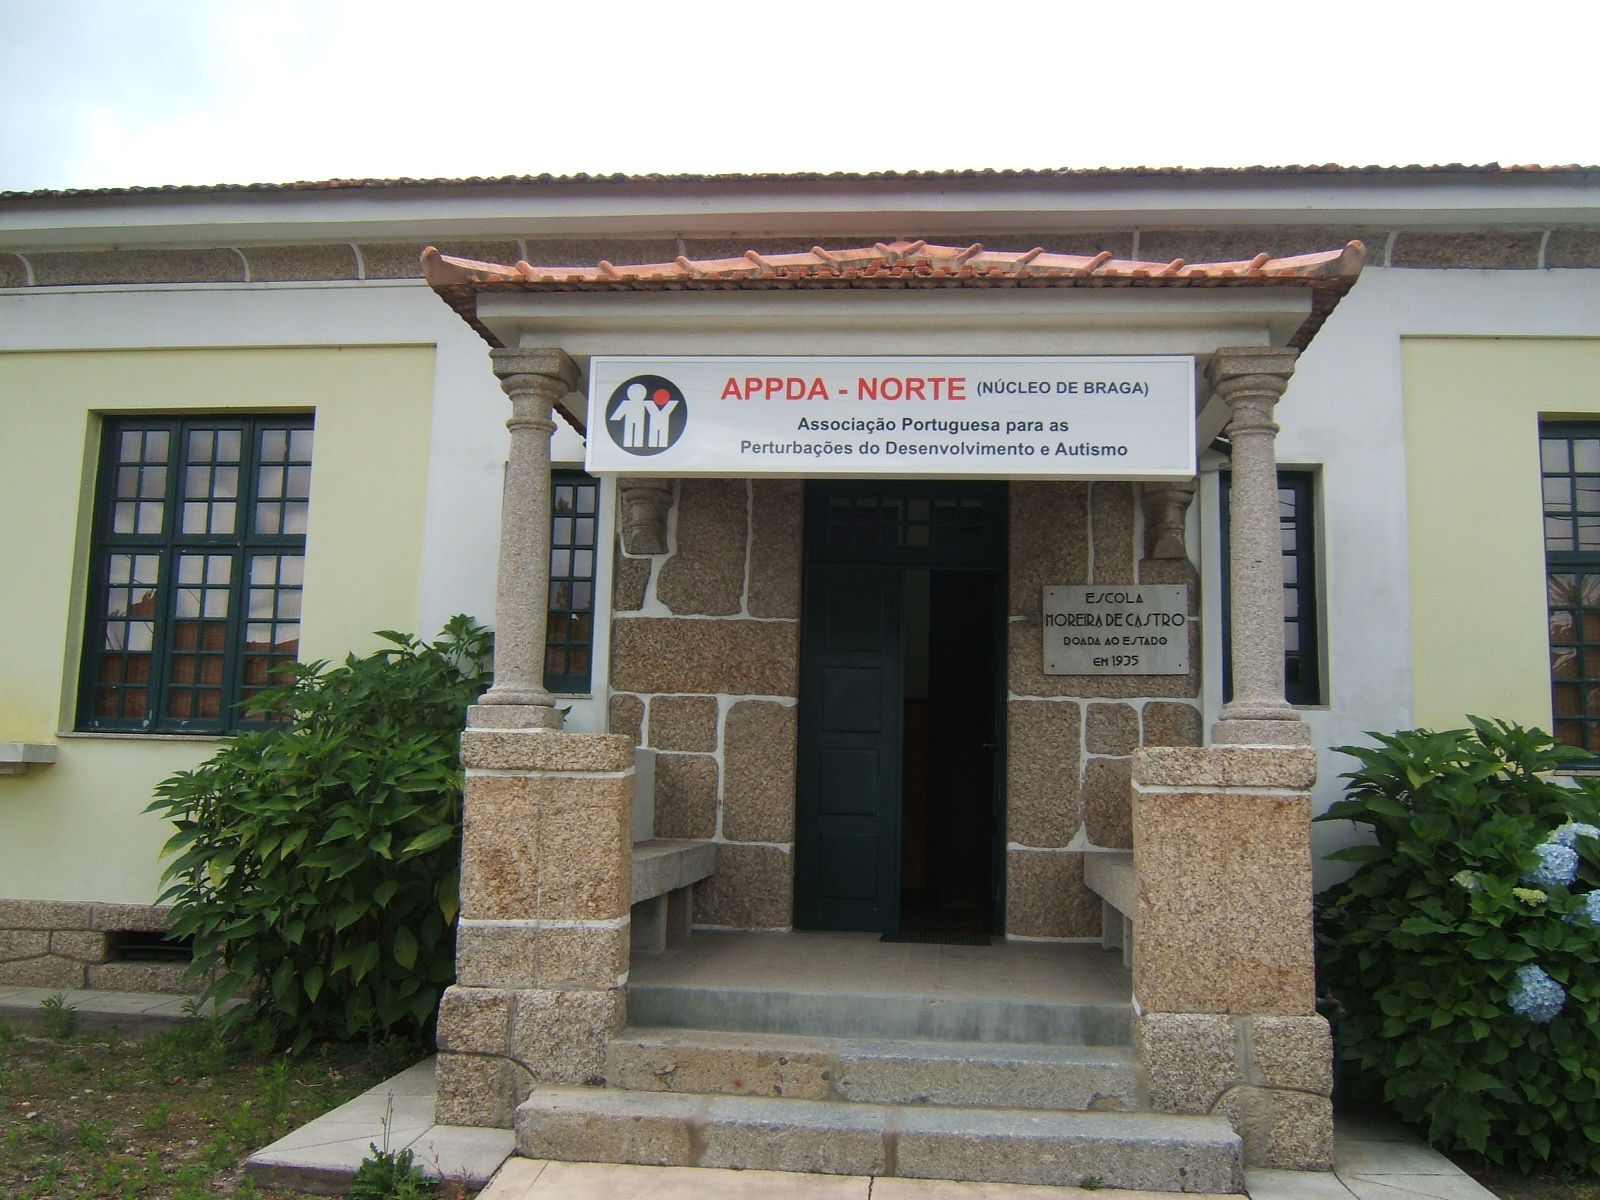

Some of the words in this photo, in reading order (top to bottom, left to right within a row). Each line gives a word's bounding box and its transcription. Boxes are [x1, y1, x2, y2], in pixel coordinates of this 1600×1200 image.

[721, 377, 829, 401] APPDA
[858, 377, 966, 401] NORTE
[976, 379, 1051, 398] (NÚCLEO
[1056, 381, 1078, 394] DE
[1084, 381, 1149, 398] BRAGA)
[797, 416, 896, 433] Associação
[902, 418, 1000, 435] Portuguesa
[1006, 421, 1044, 435] para
[1049, 421, 1069, 432] as
[740, 440, 852, 458] Perturbações
[859, 441, 880, 455] do
[885, 441, 1035, 456] Desenvolvimento
[1040, 445, 1050, 456] e
[1055, 442, 1128, 456] Autismo
[1085, 592, 1144, 604] ESCOLA
[1045, 613, 1103, 628] MOREIRA
[1105, 613, 1123, 627] DE
[1125, 613, 1185, 628] CASTRO
[1063, 636, 1101, 646] DOADA
[1104, 636, 1120, 646] AO
[1122, 636, 1168, 646] ESTADO
[1093, 657, 1109, 667] EM
[1112, 655, 1139, 667] 1935
